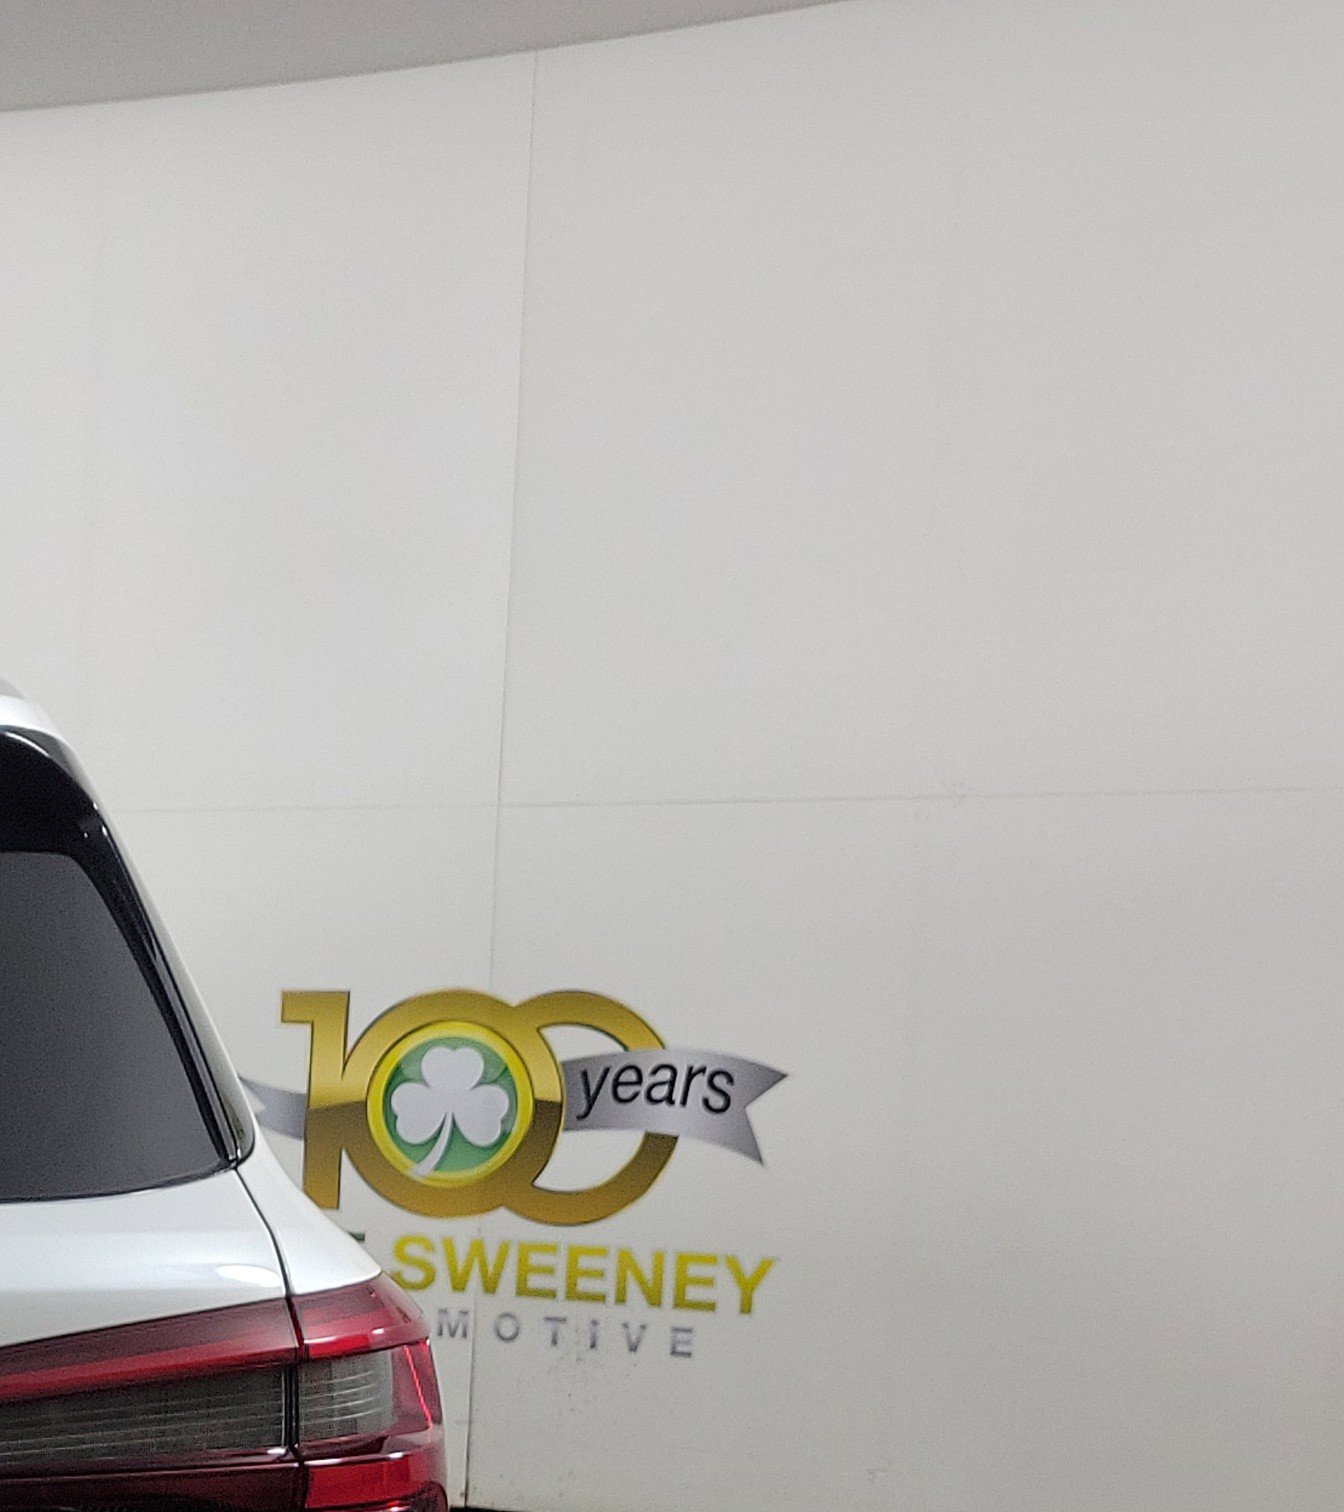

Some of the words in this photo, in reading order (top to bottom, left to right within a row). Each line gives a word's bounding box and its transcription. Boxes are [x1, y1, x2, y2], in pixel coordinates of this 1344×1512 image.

[577, 1062, 735, 1120] years
[392, 1234, 776, 1316] SWEENEY
[437, 1308, 695, 1358] MOTIVE
